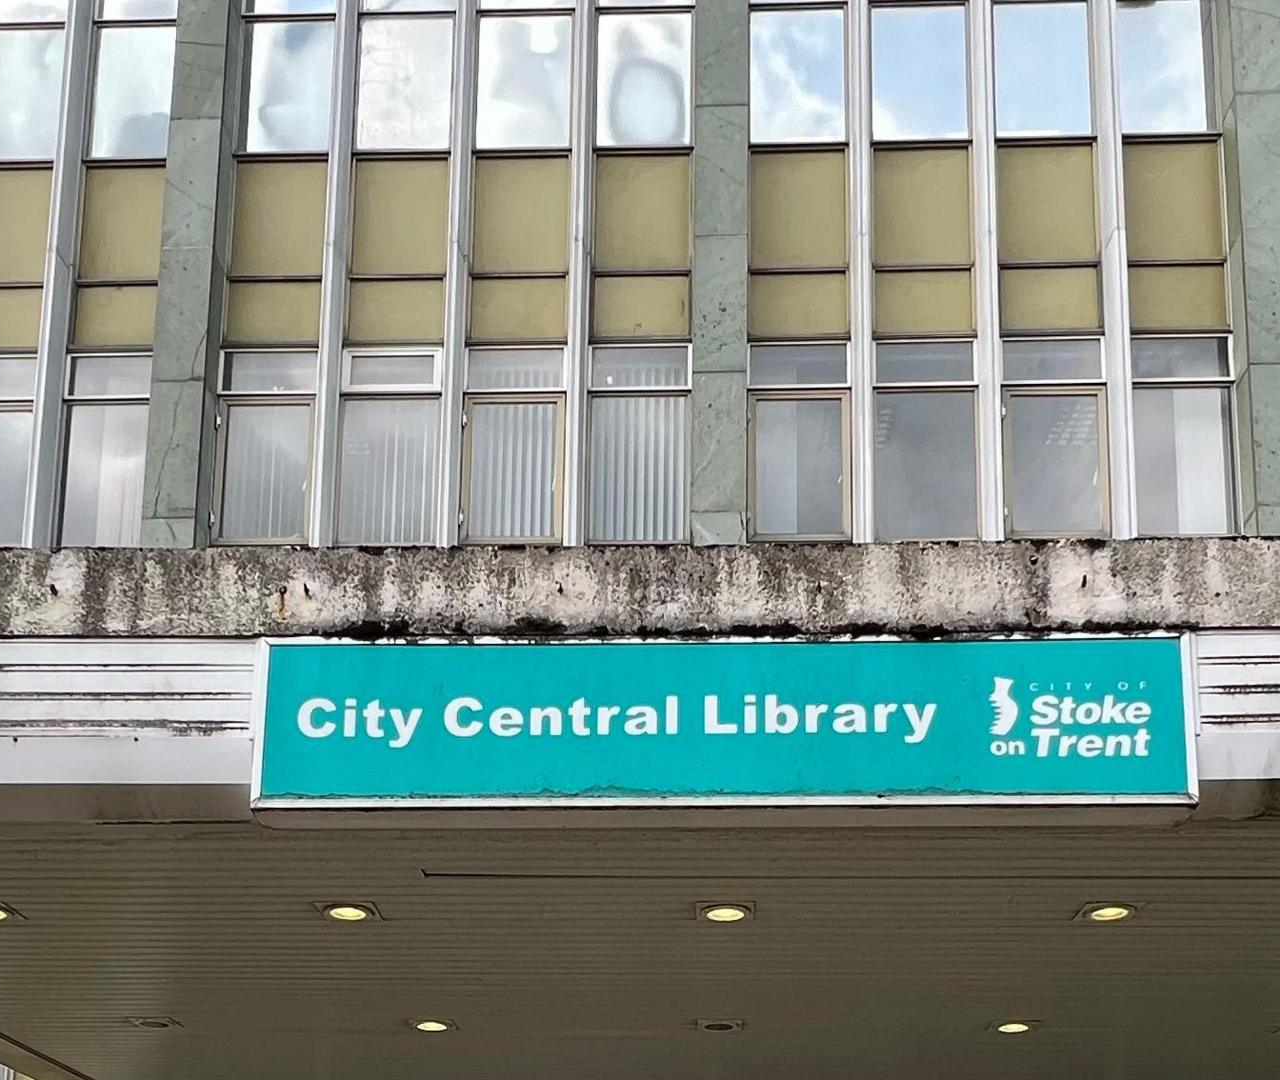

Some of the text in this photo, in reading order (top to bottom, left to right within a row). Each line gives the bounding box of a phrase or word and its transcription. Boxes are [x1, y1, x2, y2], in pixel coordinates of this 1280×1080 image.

[1029, 680, 1148, 691] CITY OF
[297, 694, 937, 748] City Central Library
[1030, 695, 1151, 725] Stoke
[990, 728, 1151, 757] on Trent
